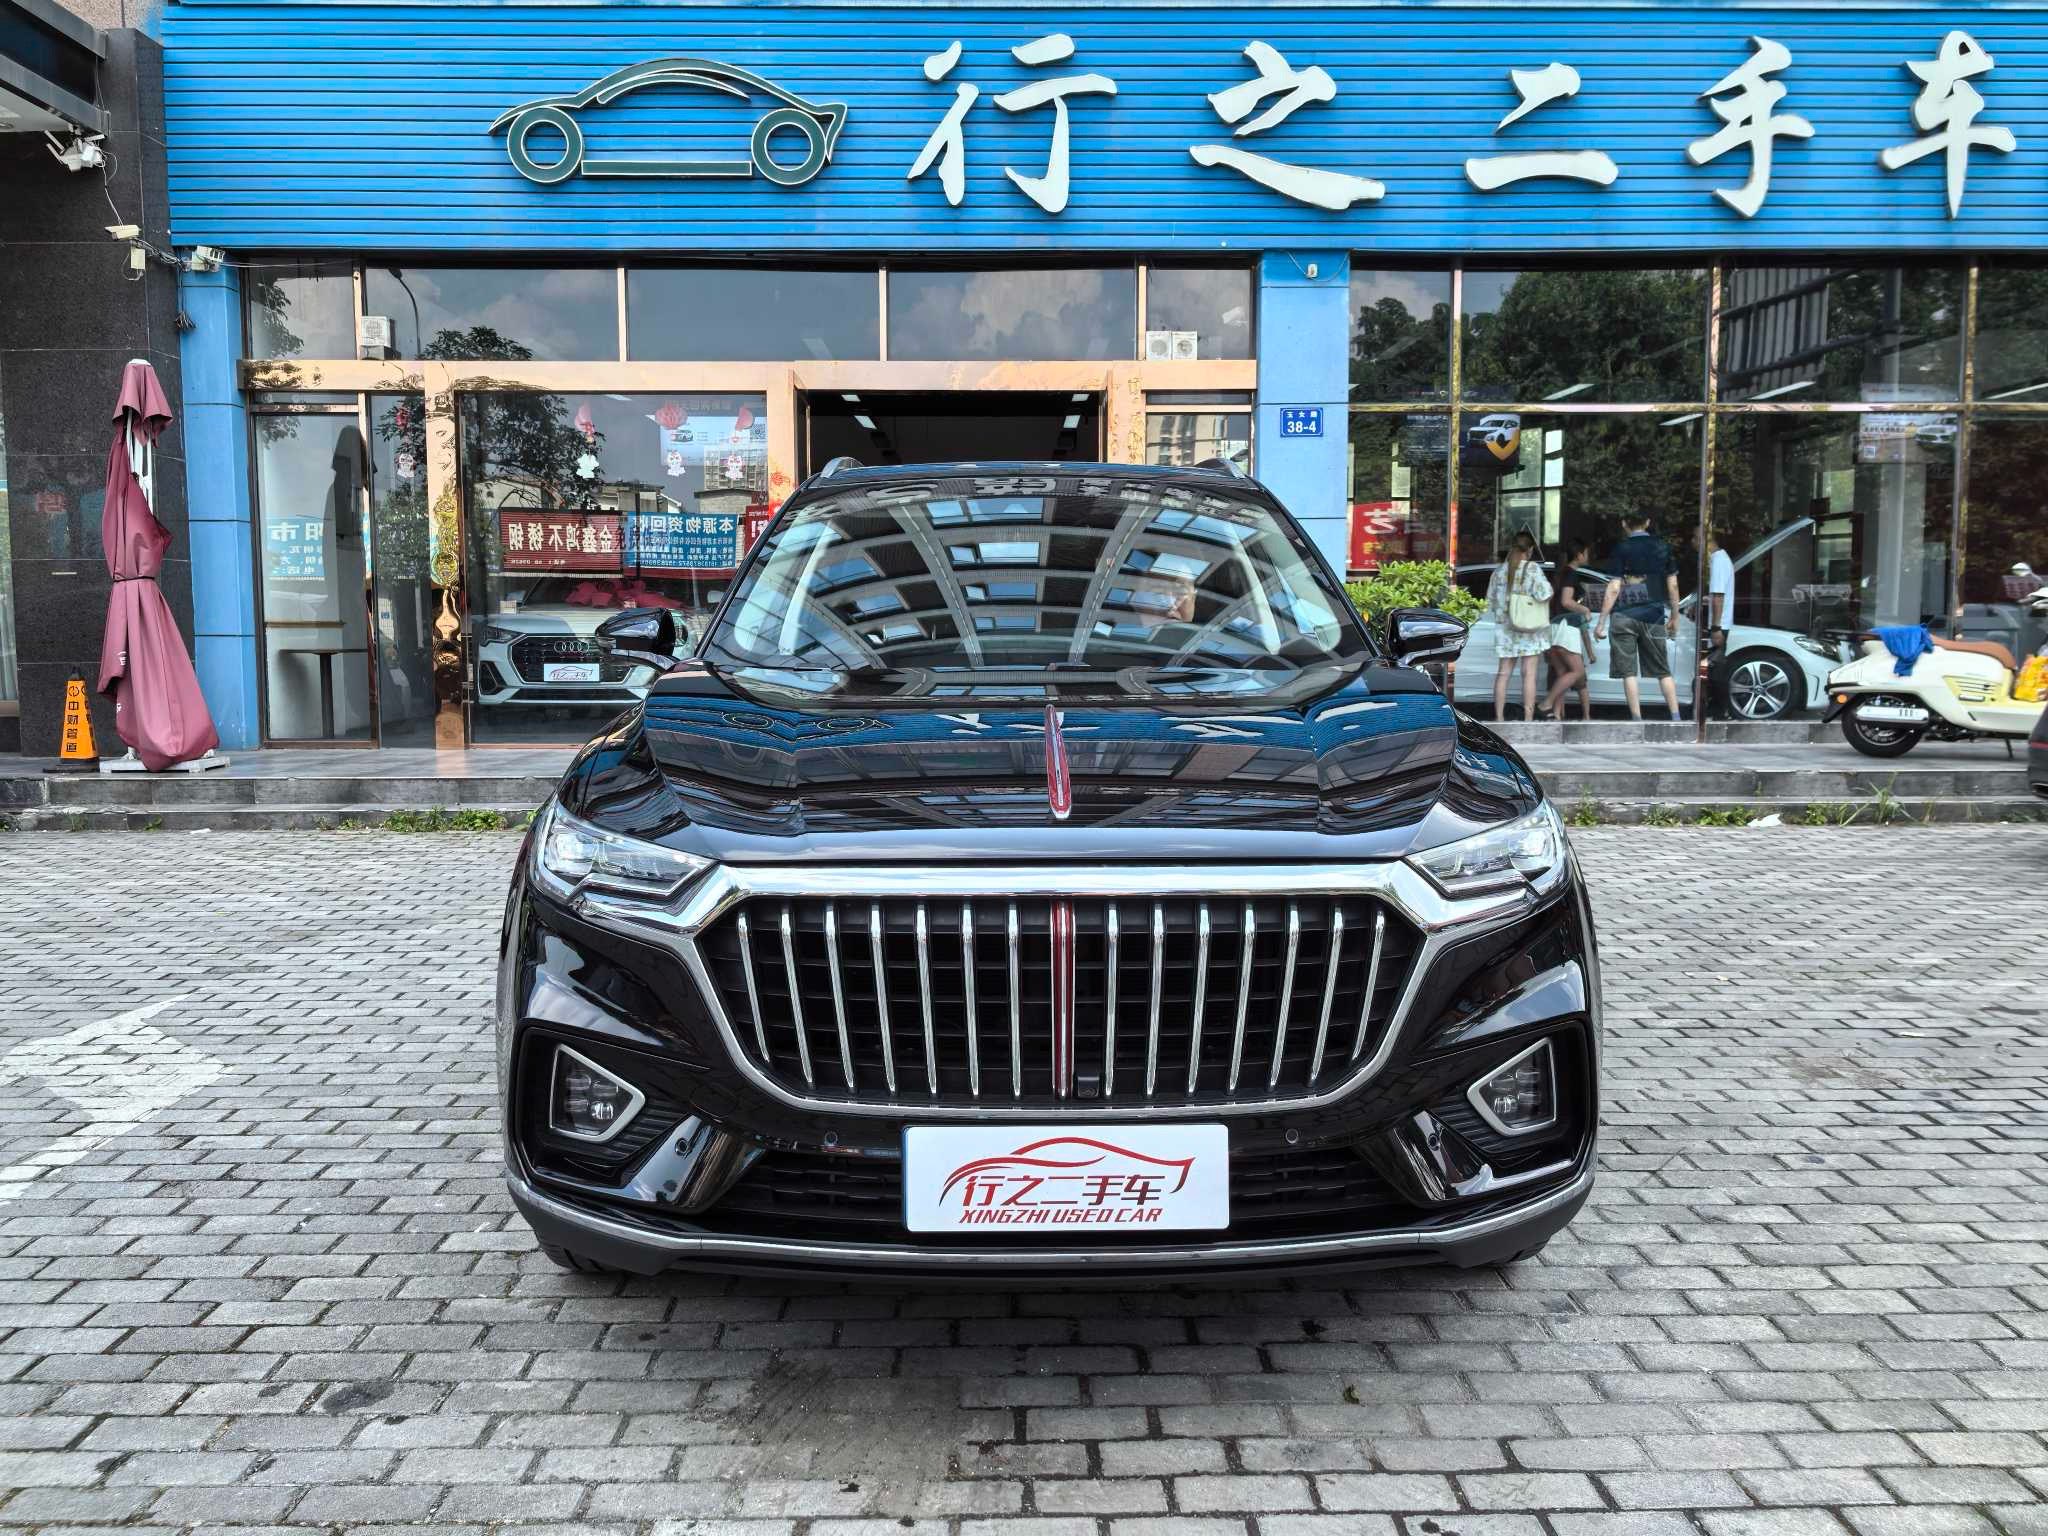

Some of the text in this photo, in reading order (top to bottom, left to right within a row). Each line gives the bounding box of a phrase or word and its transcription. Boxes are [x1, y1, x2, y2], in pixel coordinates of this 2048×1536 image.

[907, 31, 2017, 217] 行之二手车
[1287, 421, 1317, 433] 38-4
[962, 1175, 1166, 1207] 行之二手车
[959, 1208, 1163, 1224] XINGZHI USED CAR
